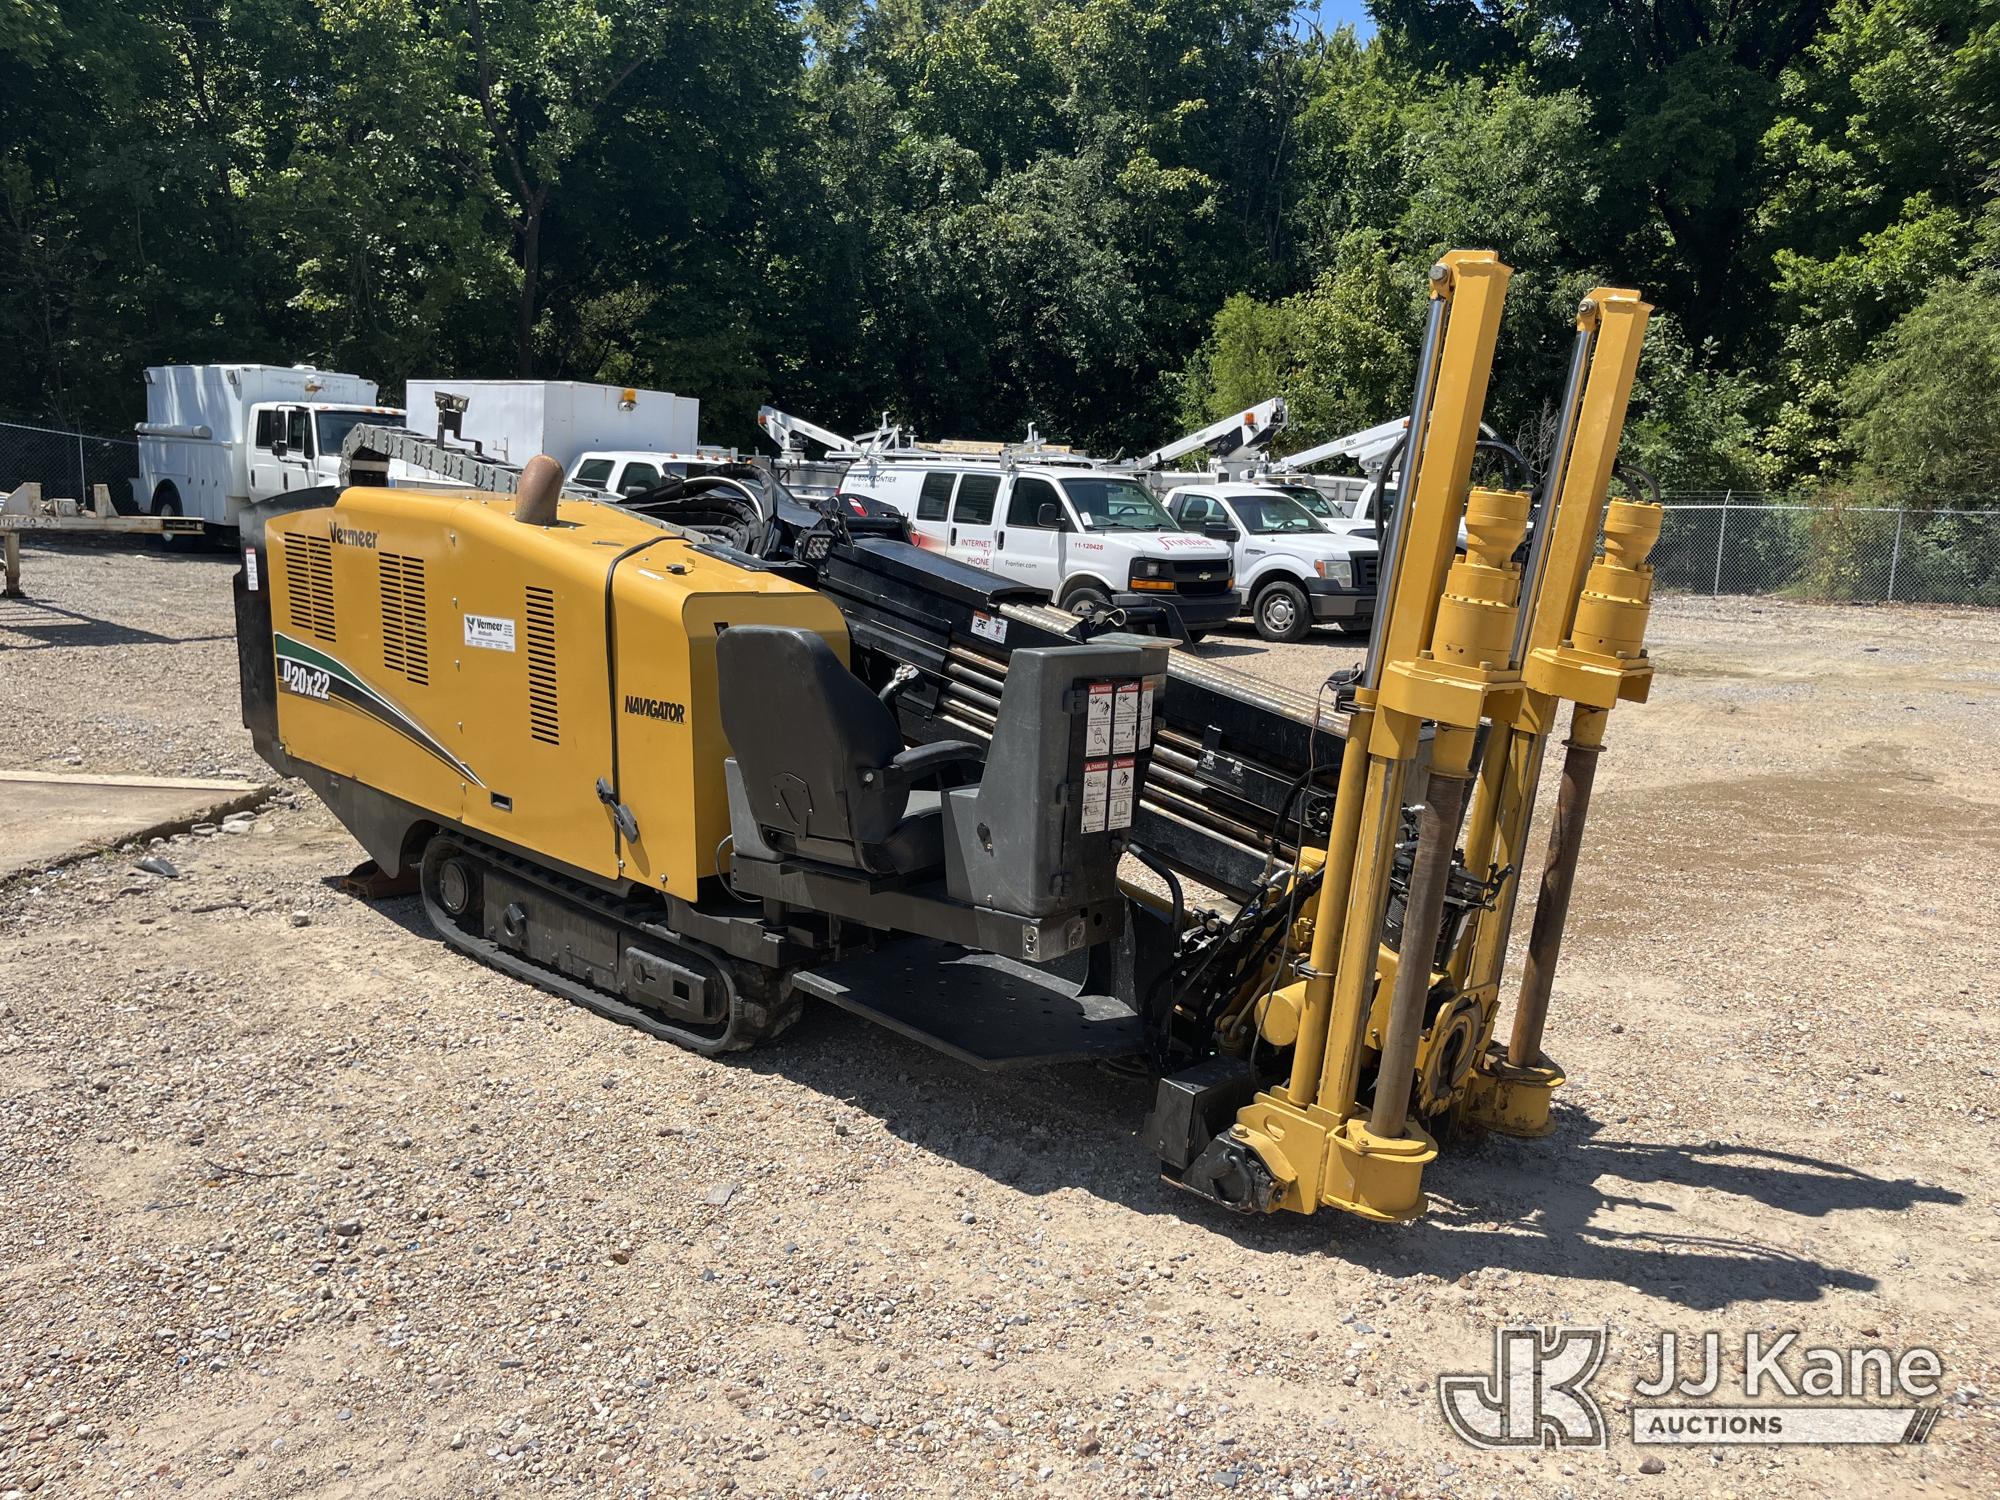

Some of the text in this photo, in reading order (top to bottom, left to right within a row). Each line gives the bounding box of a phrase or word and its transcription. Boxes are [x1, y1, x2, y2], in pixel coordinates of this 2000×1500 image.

[328, 521, 378, 549] Vermeer
[961, 539, 992, 548] INTERNET
[983, 549, 992, 557] TV
[967, 556, 990, 566] PHONE
[1005, 560, 1038, 569] Frontier.com
[476, 618, 503, 632] Vermeer
[283, 659, 331, 700] D20x22
[624, 695, 686, 724] NAVIGATOR
